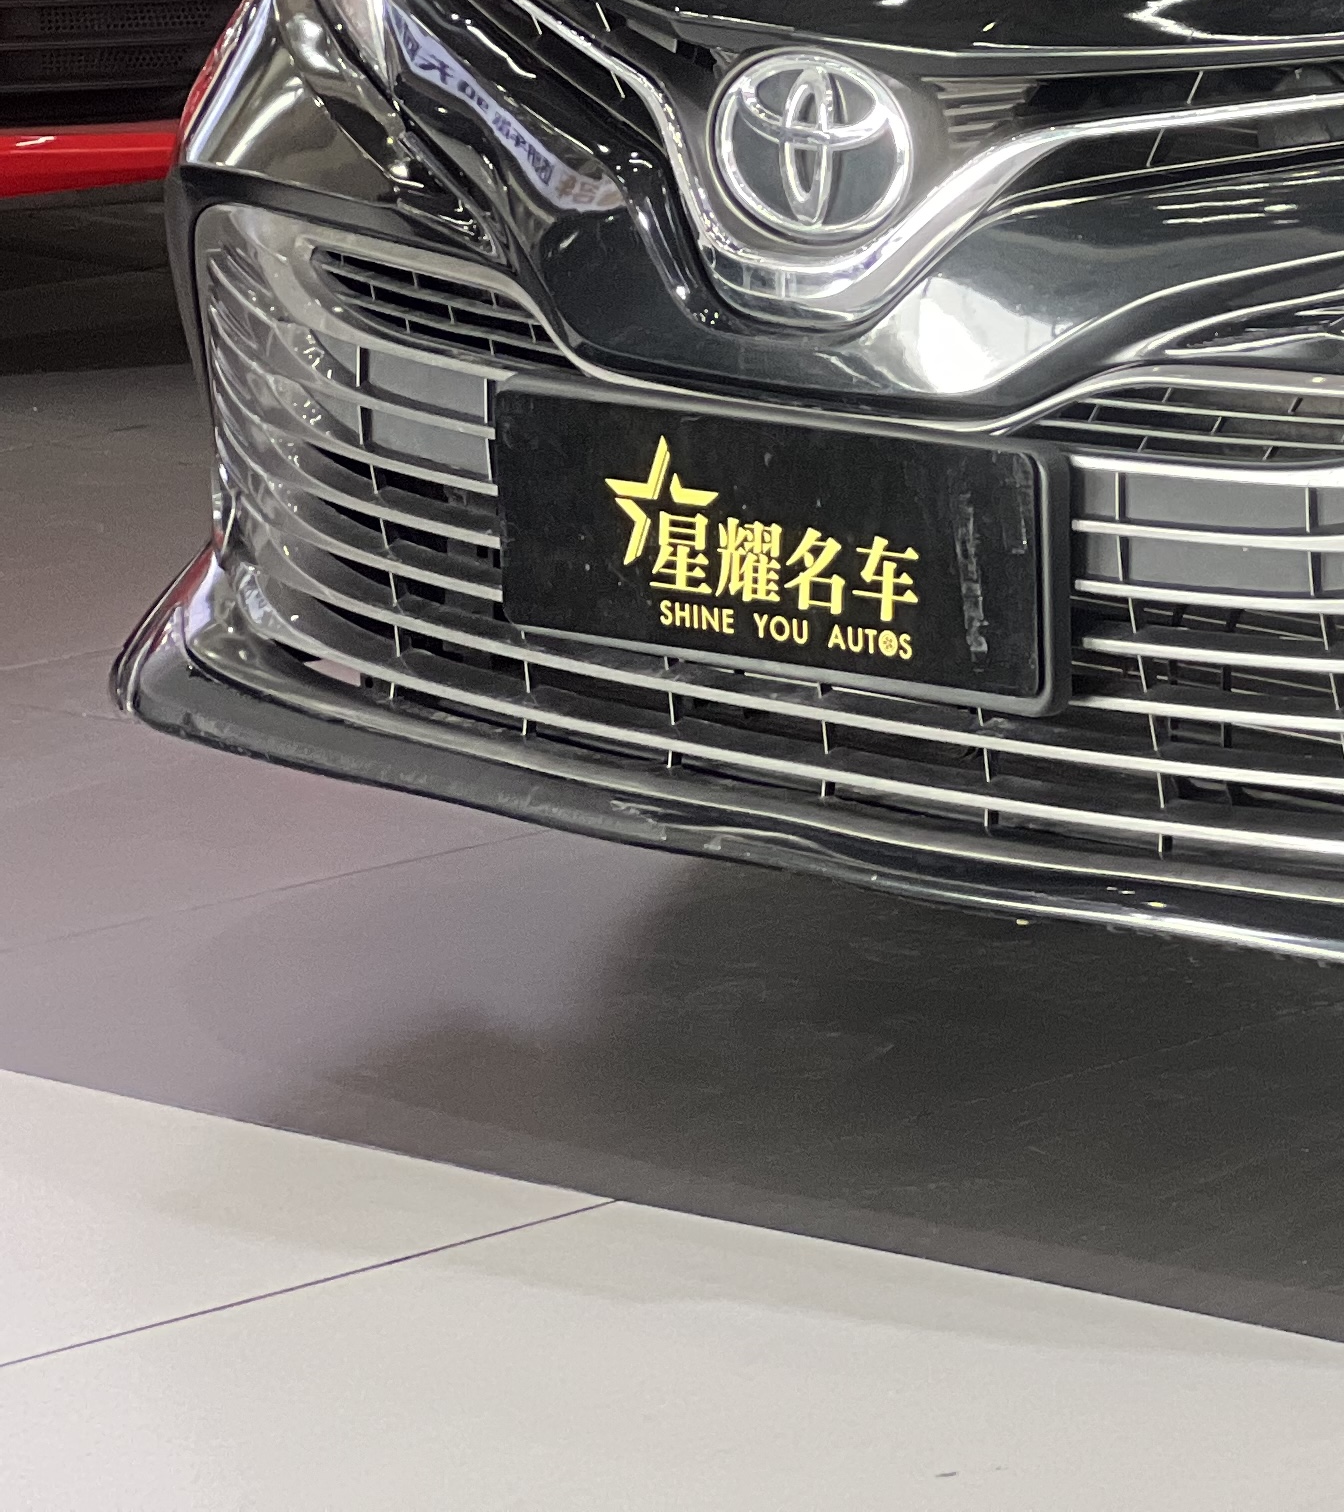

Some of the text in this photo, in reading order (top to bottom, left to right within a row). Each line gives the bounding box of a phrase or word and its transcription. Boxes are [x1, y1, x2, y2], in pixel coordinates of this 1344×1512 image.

[649, 510, 919, 621] 星耀名车
[660, 600, 913, 661] SHINE YOU AUTOS
